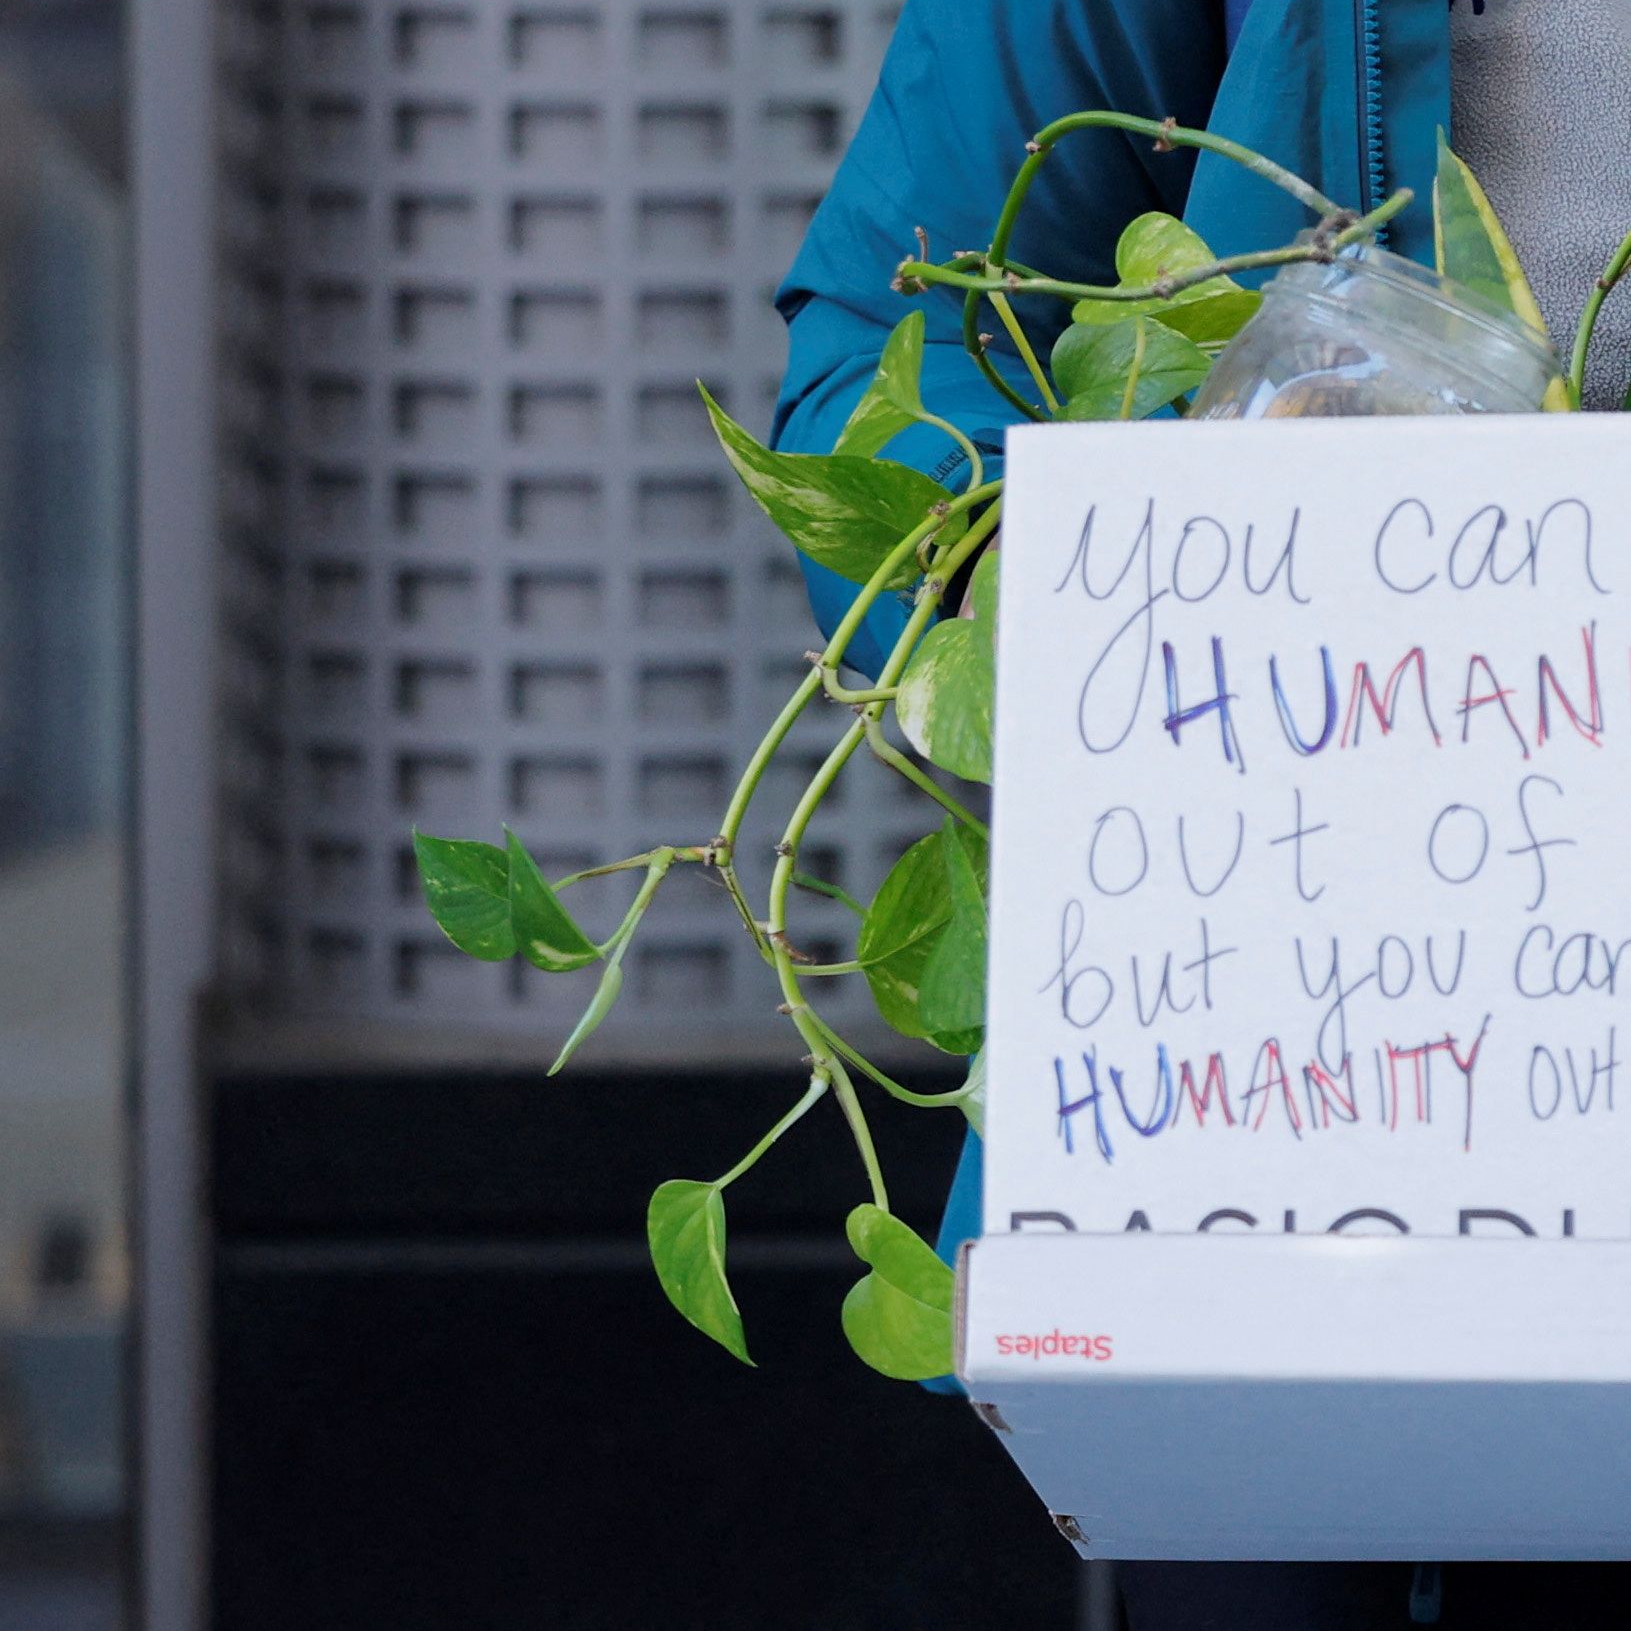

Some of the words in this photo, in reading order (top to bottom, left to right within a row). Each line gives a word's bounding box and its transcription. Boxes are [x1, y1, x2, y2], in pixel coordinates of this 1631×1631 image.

[1373, 496, 1612, 598] can
[1088, 787, 1333, 899] out
[1427, 774, 1577, 913] of
[1040, 901, 1240, 1029] but
[1296, 927, 1469, 1076] you
[1050, 1012, 1492, 1166] HUMANITY
[1528, 1025, 1623, 1119] out
[995, 1328, 1113, 1361] Staples
